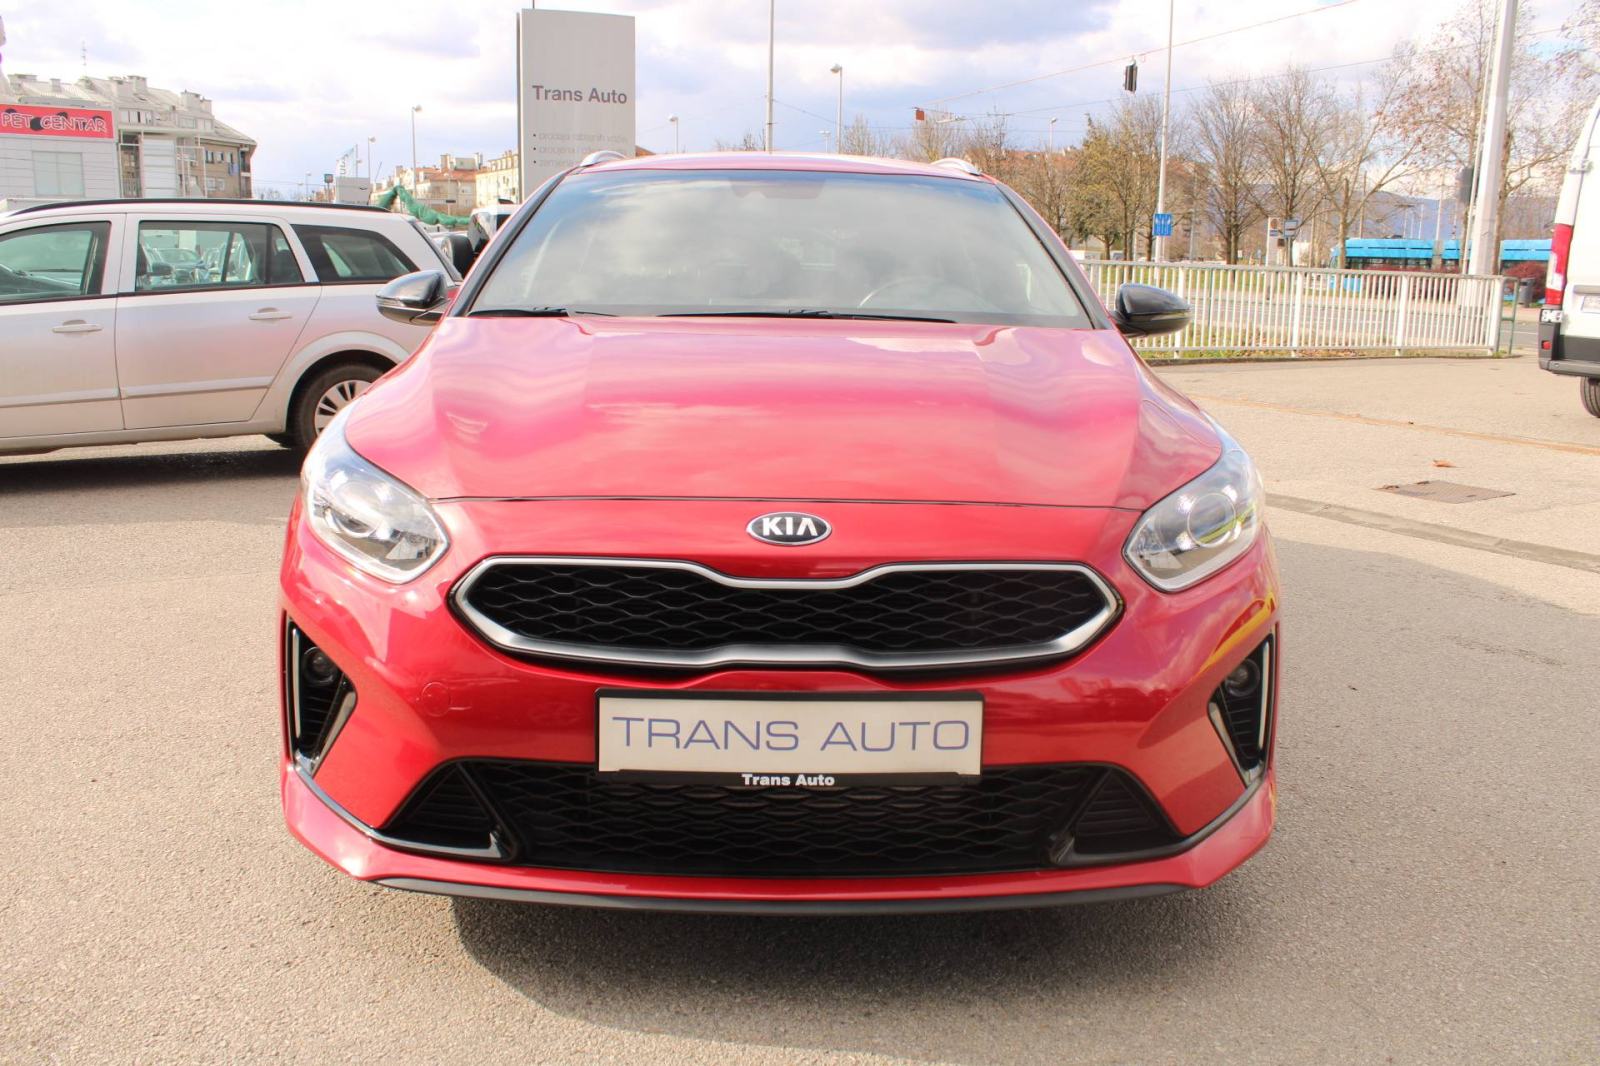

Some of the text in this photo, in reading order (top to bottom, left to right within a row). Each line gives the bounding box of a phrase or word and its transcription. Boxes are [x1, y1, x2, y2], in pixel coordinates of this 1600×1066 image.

[533, 85, 628, 104] Trans Auto
[1, 113, 107, 132] PET CENTAR
[762, 516, 819, 536] KIA
[612, 716, 970, 752] TRANS AUTO
[741, 773, 835, 787] Trans Auto
